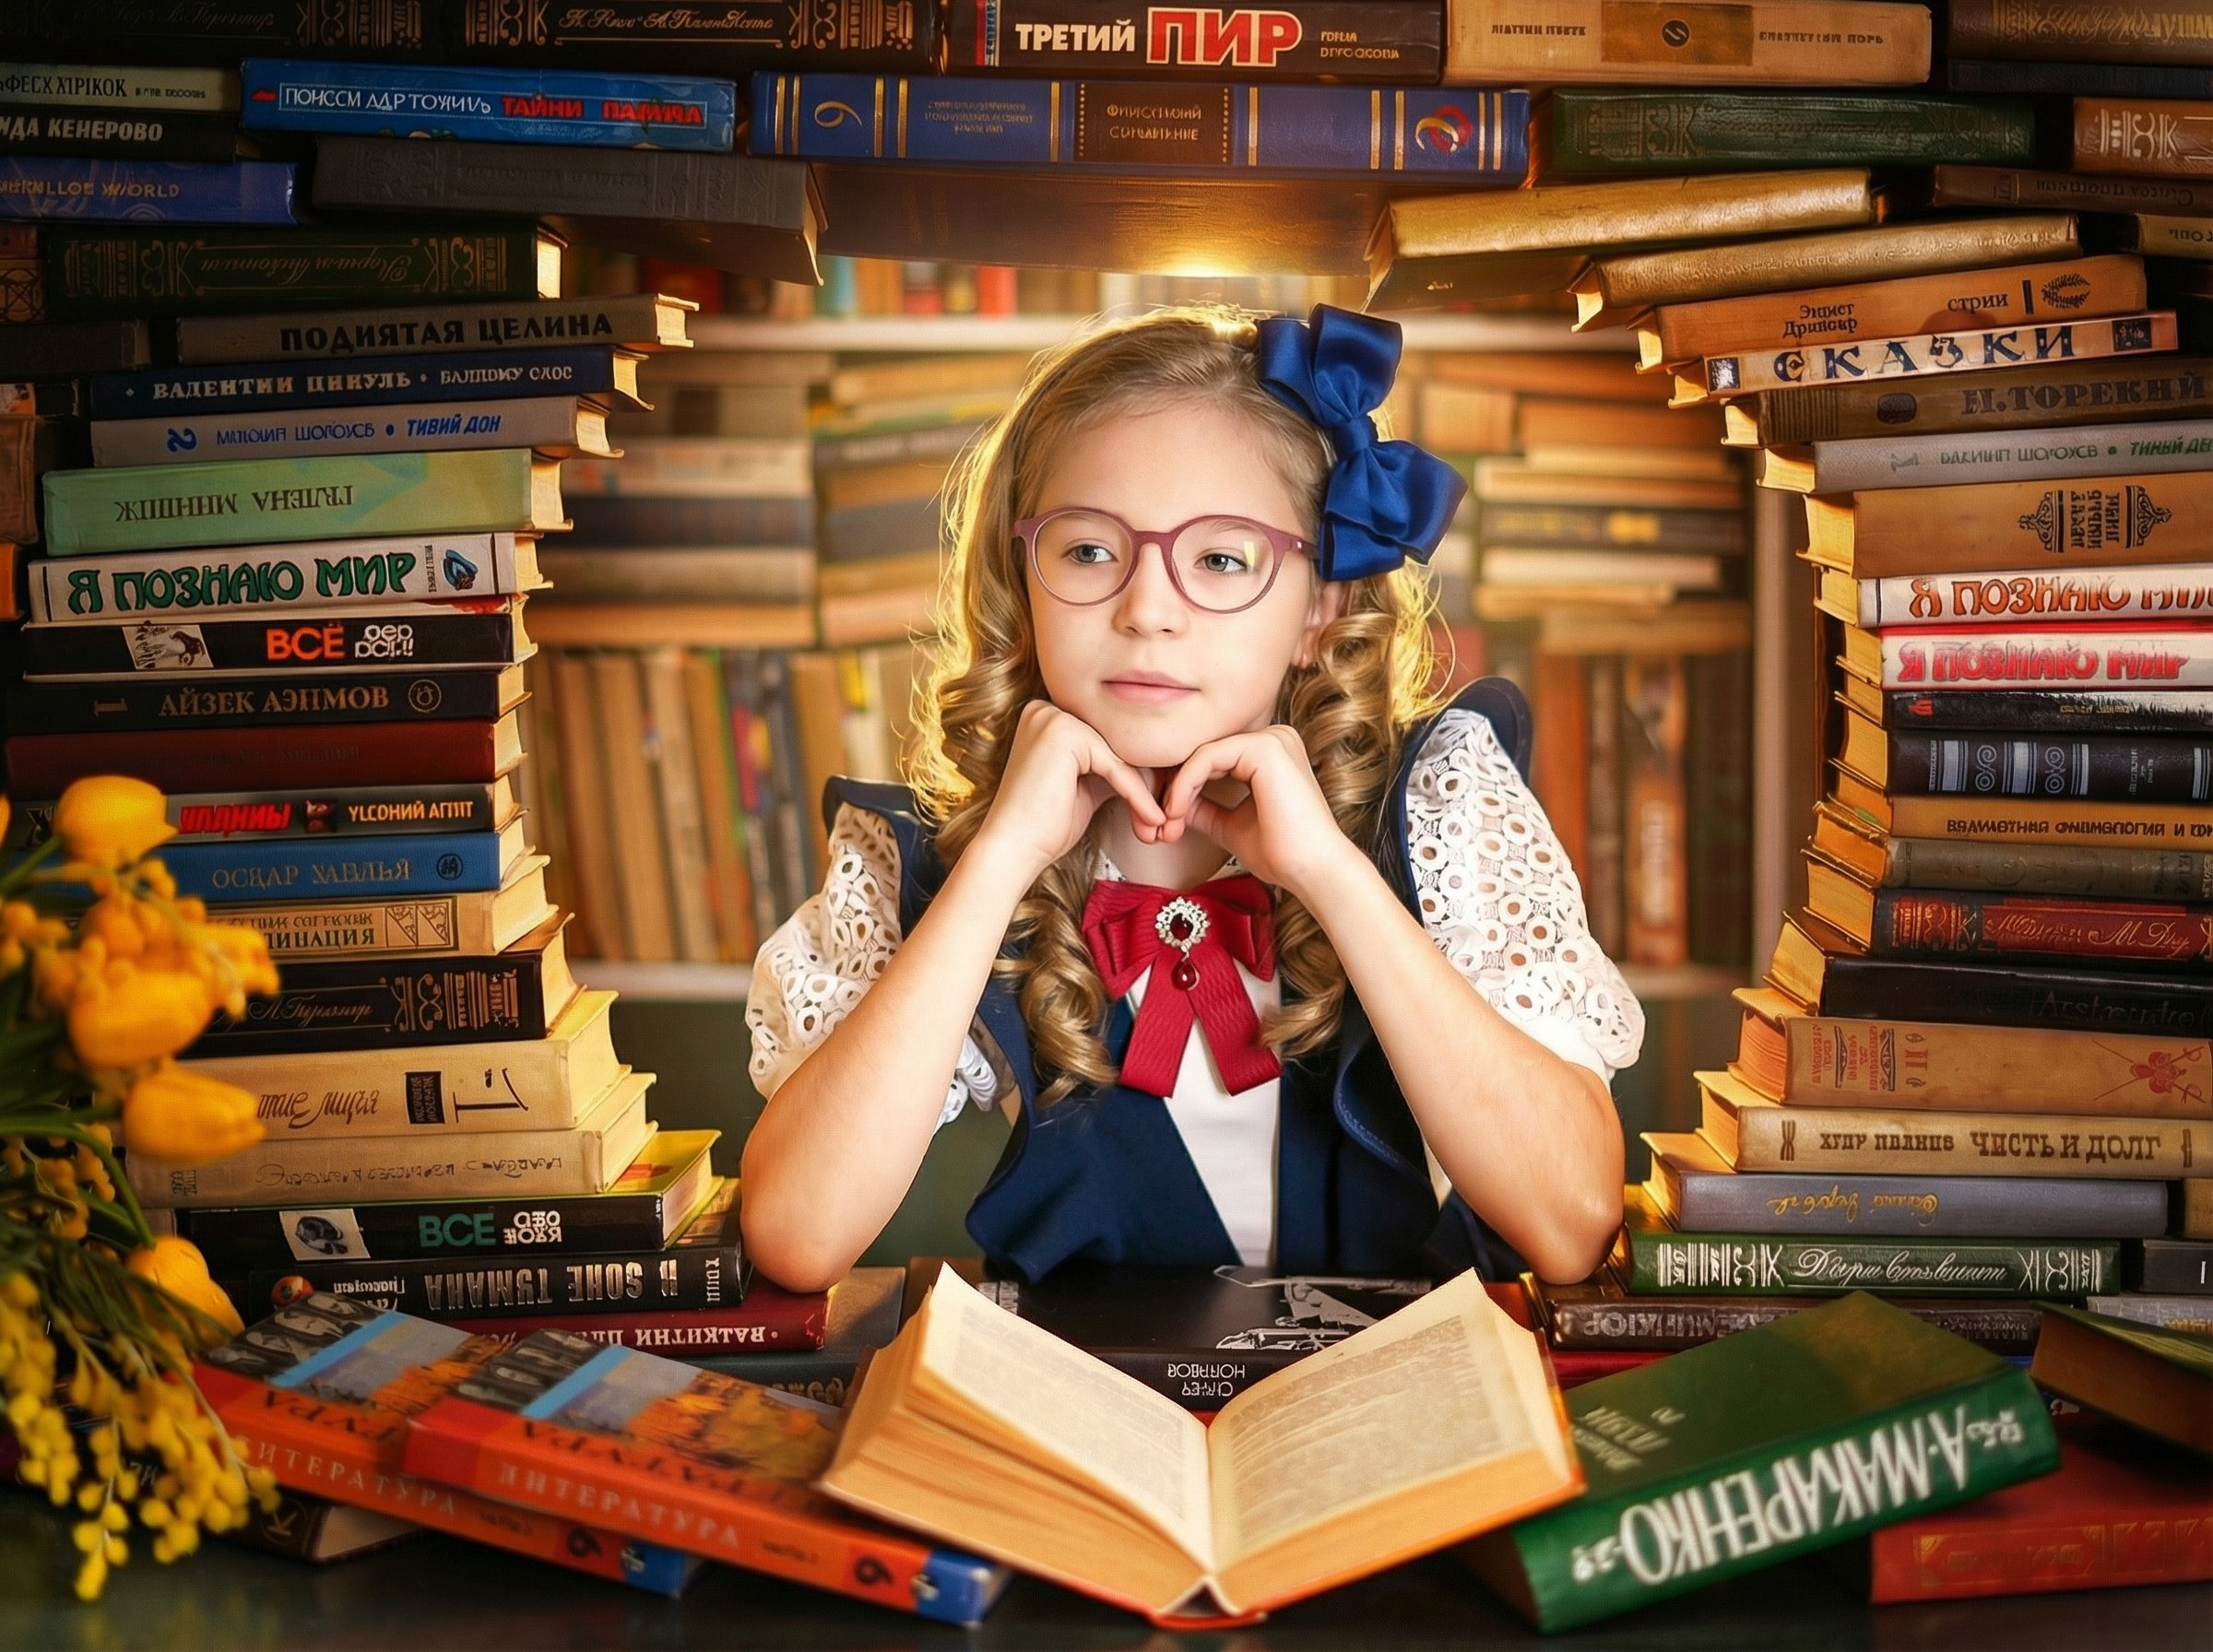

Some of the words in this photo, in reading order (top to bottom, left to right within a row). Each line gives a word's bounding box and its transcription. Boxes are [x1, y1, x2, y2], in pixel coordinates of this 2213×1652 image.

[1015, 18, 1135, 52] ТРЕТИЙ
[1146, 6, 1303, 67] ПИР
[479, 313, 613, 345] ЦЕЛИНА
[464, 415, 502, 435] ДОН
[67, 570, 103, 615] Я
[112, 560, 304, 612] ПОЗНАЮ
[315, 552, 416, 597] МИР
[1909, 578, 1943, 618] Я
[1952, 575, 2132, 616] ПОЗНАЮ
[266, 620, 346, 661] ВСЁ
[1898, 642, 1927, 682] Я
[1932, 641, 2101, 682] ПОЗНАЮ
[159, 687, 255, 716] АЙЗЕК
[418, 1212, 497, 1247] ВСЕ
[424, 1266, 553, 1311] ТУМАНА
